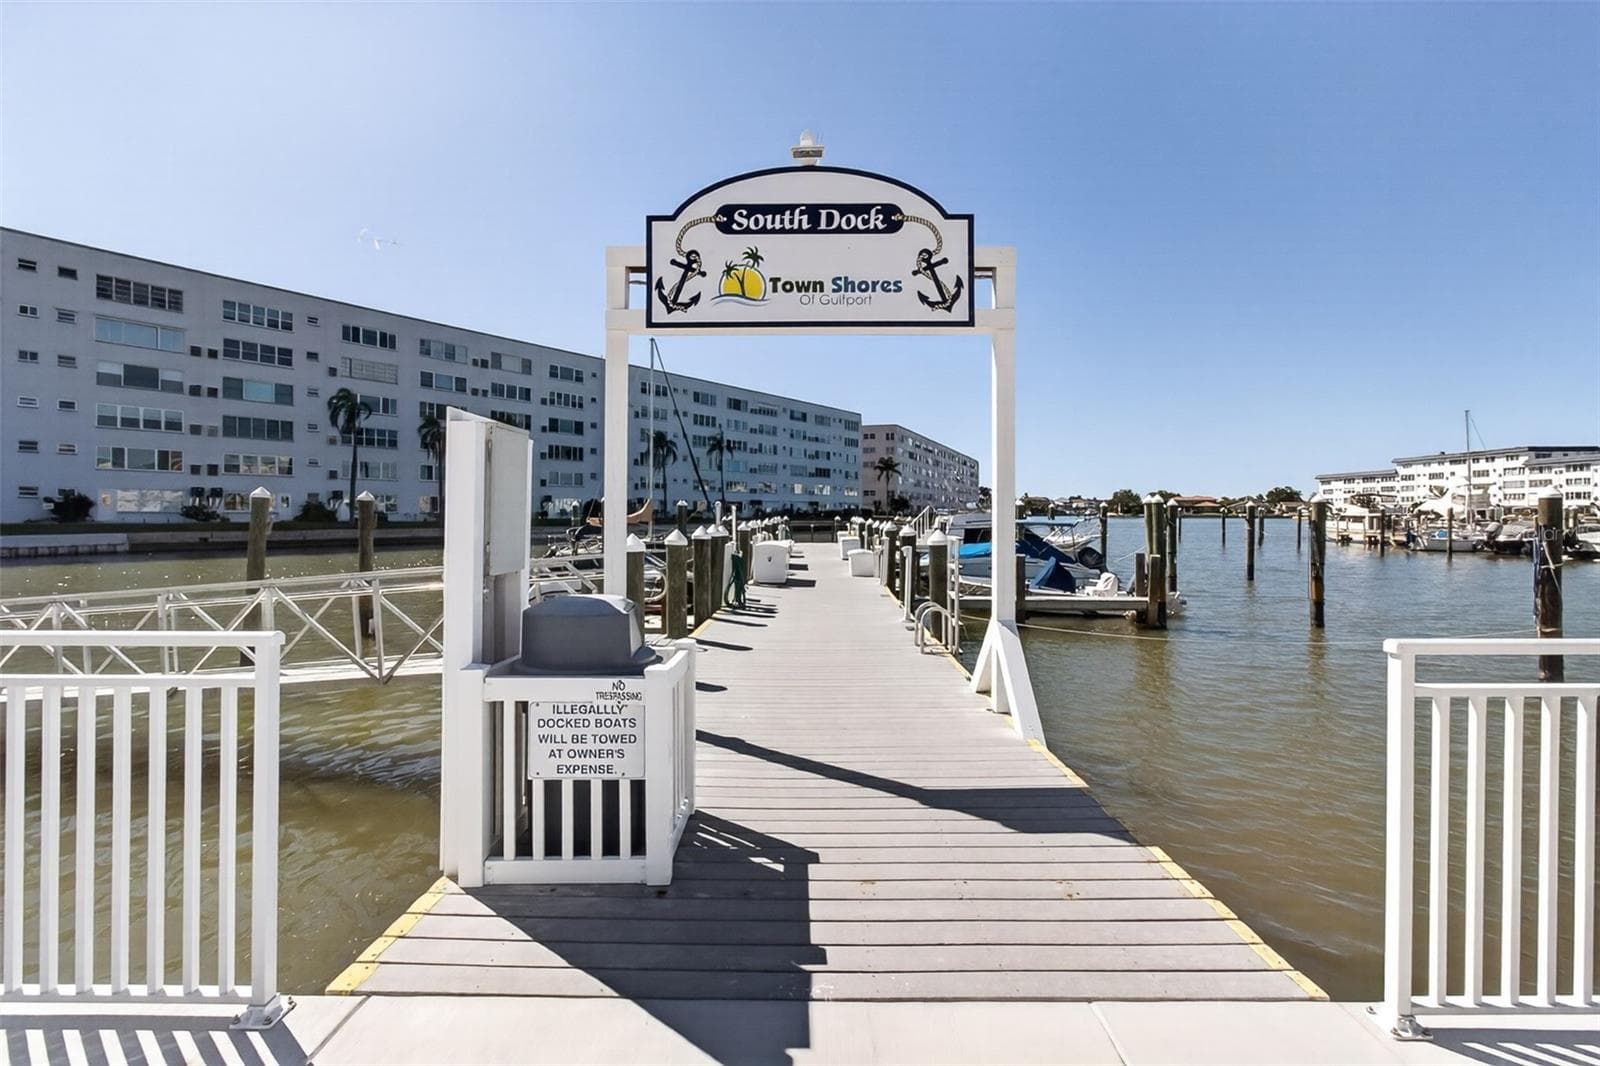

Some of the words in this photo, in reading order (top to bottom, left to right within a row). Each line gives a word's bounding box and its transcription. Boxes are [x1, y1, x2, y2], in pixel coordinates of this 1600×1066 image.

[732, 206, 811, 231] South
[817, 206, 887, 231] Dock
[769, 277, 824, 293] Town
[831, 276, 903, 293] Shores
[799, 294, 815, 306] Of
[819, 294, 872, 307] Gulfport
[612, 681, 626, 691] NO
[596, 691, 643, 701] TRESPASSING
[552, 704, 625, 715] ILLEGALLLY
[537, 718, 591, 729] DOCKED
[595, 718, 637, 729] BOATS
[538, 734, 567, 744] WILL
[571, 734, 588, 744] BE
[591, 734, 638, 744] TOWED
[548, 749, 564, 759] AT
[567, 748, 625, 759] OWNER'S
